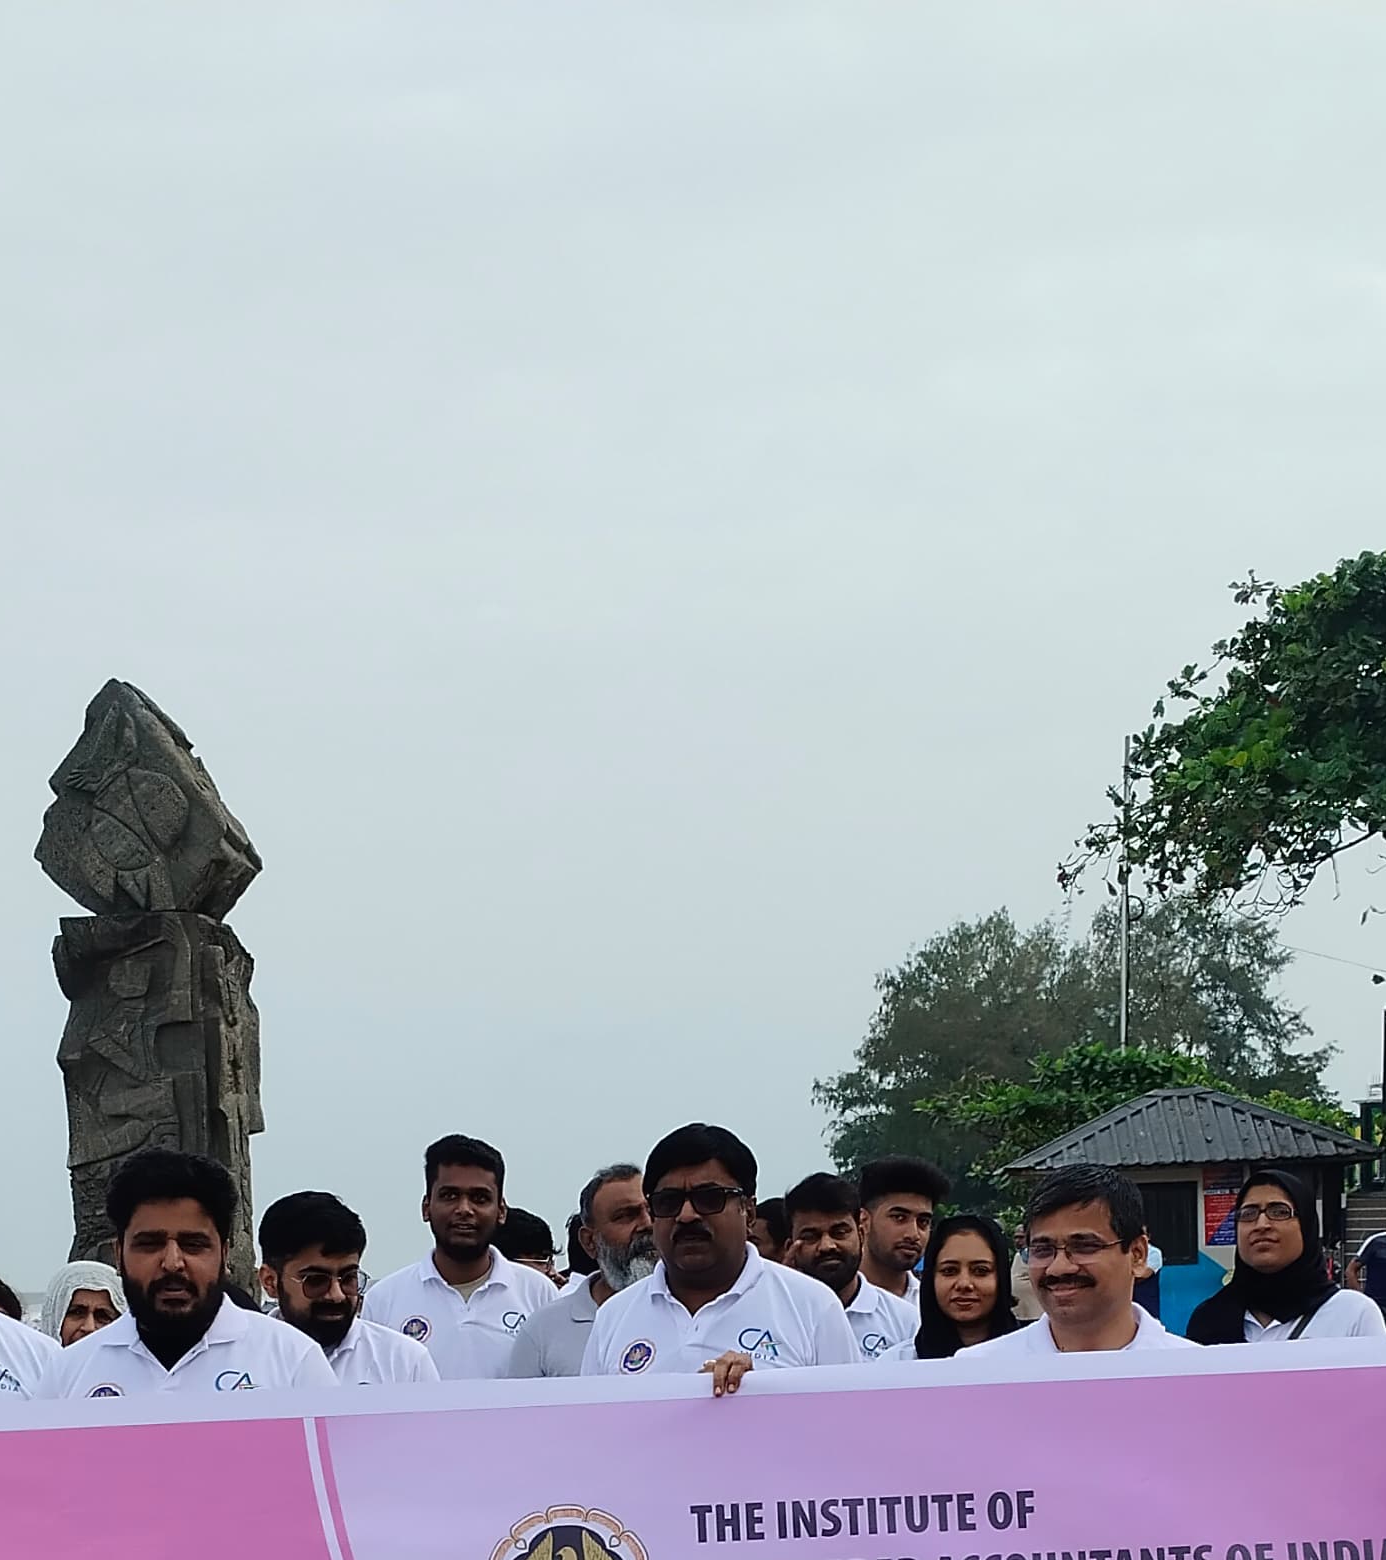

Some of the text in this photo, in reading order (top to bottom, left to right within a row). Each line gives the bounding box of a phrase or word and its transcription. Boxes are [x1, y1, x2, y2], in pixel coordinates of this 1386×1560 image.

[690, 1490, 1035, 1543] THE INSTITUTE OF
